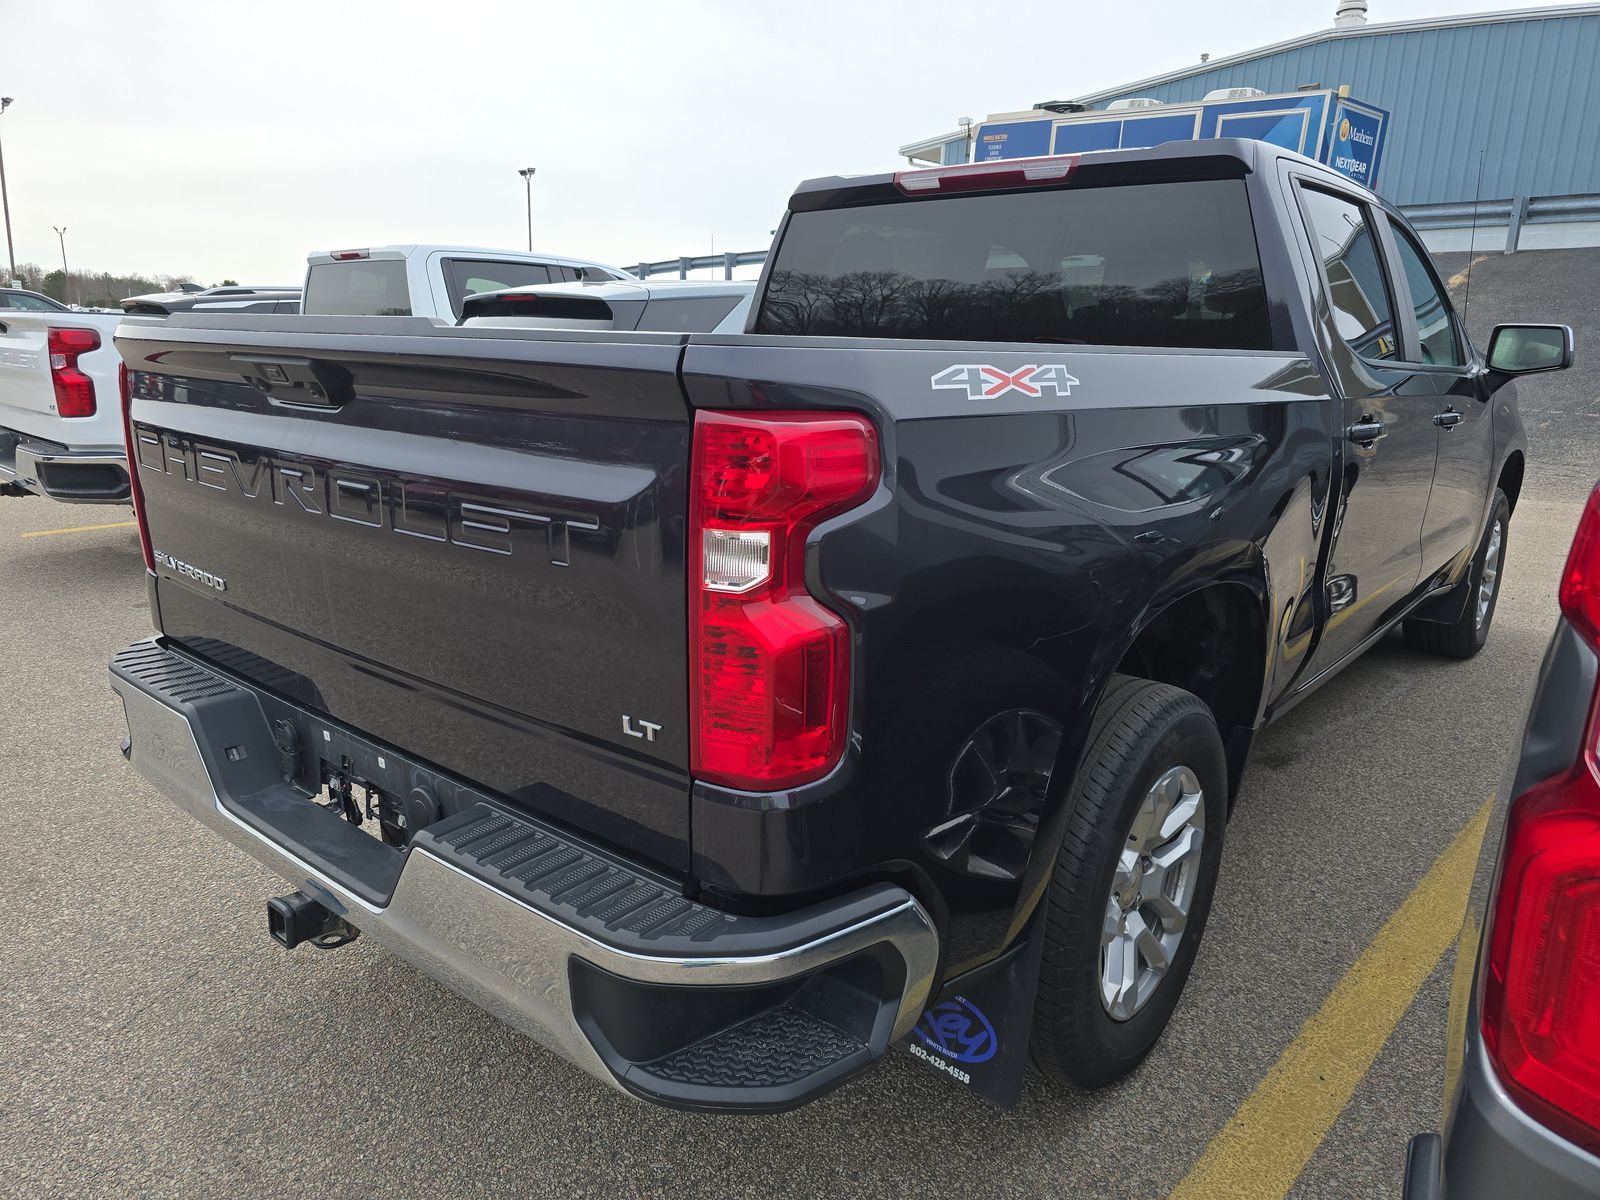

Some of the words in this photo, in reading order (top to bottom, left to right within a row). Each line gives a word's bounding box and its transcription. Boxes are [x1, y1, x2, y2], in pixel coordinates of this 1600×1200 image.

[1349, 126, 1373, 145] Manheim
[1335, 156, 1366, 173] NEXTGEAR
[136, 427, 599, 567] CHEVROLET
[153, 550, 227, 592] SILVERADO
[622, 714, 663, 742] LT
[909, 1043, 971, 1084] 802-428-4558
[942, 1048, 958, 1059] RIVER
